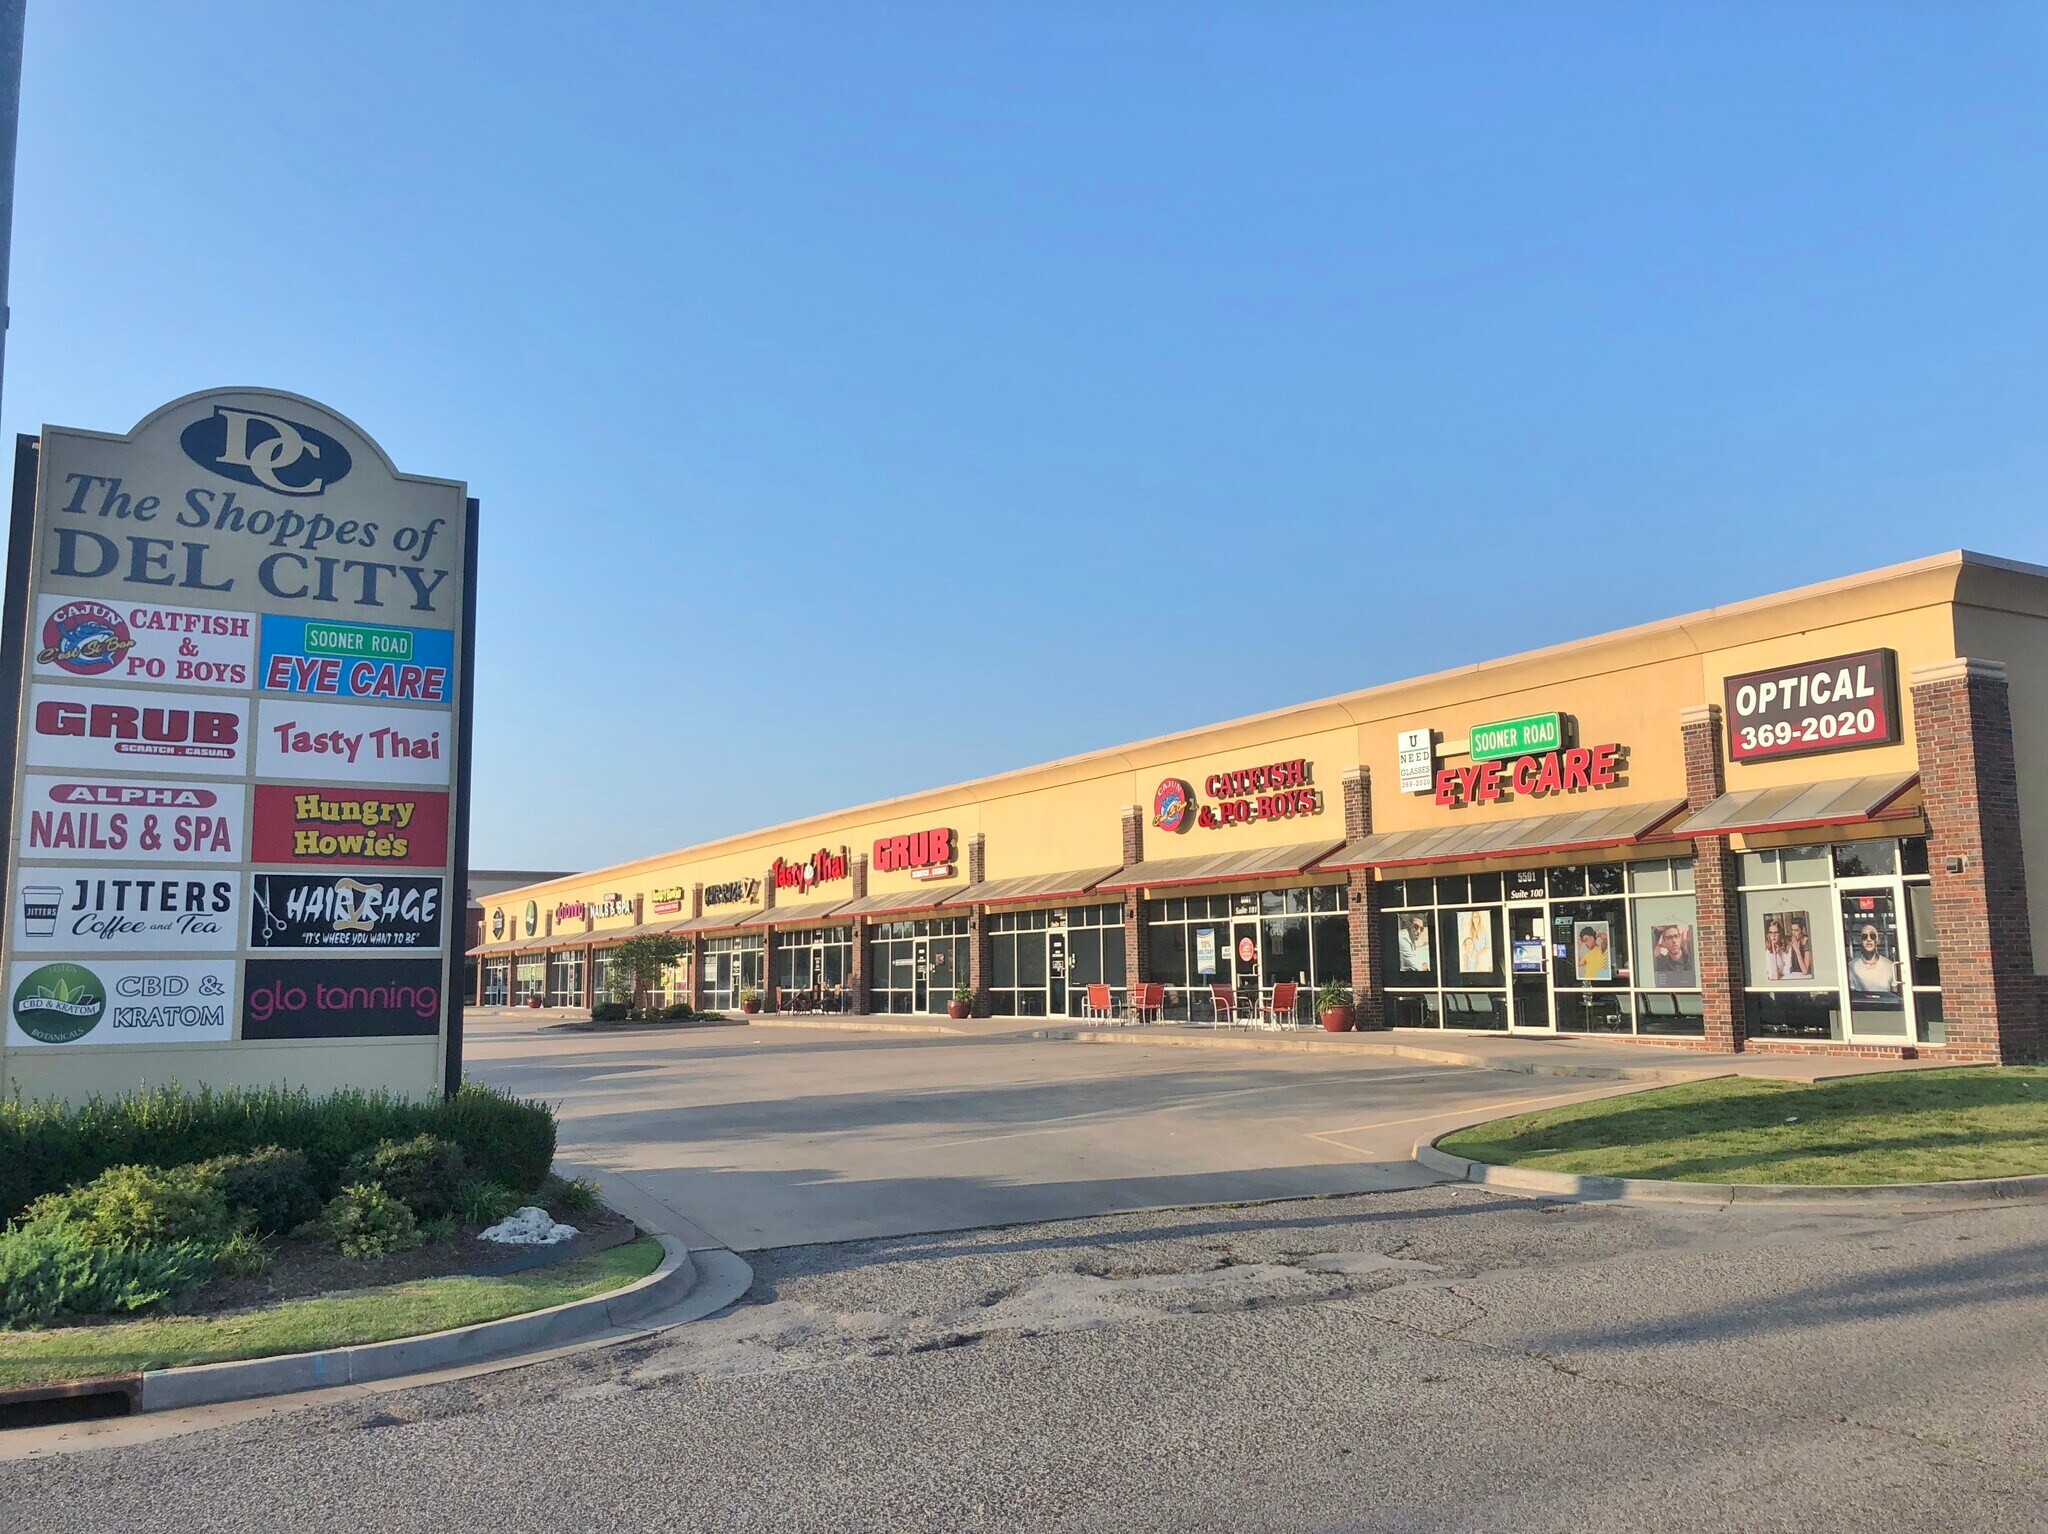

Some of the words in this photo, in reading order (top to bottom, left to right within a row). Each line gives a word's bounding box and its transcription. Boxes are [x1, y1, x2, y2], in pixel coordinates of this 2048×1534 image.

[62, 472, 160, 521] The
[177, 488, 379, 550] Shoppes
[393, 518, 446, 562] of
[50, 527, 234, 592] DEL
[259, 552, 449, 611] CITY
[53, 604, 123, 625] CAJUN
[129, 609, 250, 638] CATFISH
[178, 637, 200, 657] &
[310, 630, 364, 650] SOONER
[371, 635, 408, 654] ROAD
[126, 657, 166, 678] PO
[176, 660, 246, 684] BOYS
[265, 654, 342, 694] EYE
[350, 660, 447, 701] CARE
[1735, 665, 1875, 717] OPTICAL
[35, 700, 240, 744] GRUB
[1740, 708, 1875, 750] 369-2020
[120, 744, 175, 755] SCRATCH
[185, 747, 230, 757] CASUAL
[273, 721, 363, 763] Tasty
[369, 727, 440, 759] Thai
[1409, 734, 1418, 748] U
[1474, 727, 1518, 752] SOONER
[1523, 722, 1555, 745] ROAD
[1400, 751, 1430, 764] NEED
[1400, 765, 1430, 777] GLASSES
[1157, 780, 1182, 796] CAJUN
[1205, 759, 1304, 798] CATFISH
[1435, 760, 1502, 806] EYE
[1512, 743, 1617, 795] CARE
[67, 787, 201, 805] ALPHA
[293, 794, 415, 828] Hungry
[1198, 805, 1215, 828] &
[30, 810, 128, 850] NAILS
[140, 814, 162, 850] &
[173, 815, 231, 852] SPA
[293, 829, 408, 857] Howie's
[873, 827, 949, 870] GRUB
[772, 858, 804, 894] Tasty
[814, 845, 847, 881] Thai
[1517, 872, 1536, 883] 5501
[71, 879, 232, 913] JITTERS
[287, 885, 354, 923] HAIR
[361, 887, 438, 923] RAGE
[1511, 889, 1529, 899] Suite
[1530, 888, 1544, 898] 100
[27, 908, 57, 916] JITTERS
[1235, 906, 1248, 914] Suite
[71, 913, 147, 940] Coffee
[150, 922, 173, 931] and
[176, 913, 222, 934] Tea
[322, 932, 350, 944] WHERE
[352, 932, 367, 945] YOU
[370, 932, 392, 944] WANT
[393, 932, 404, 944] TO
[115, 975, 189, 997] CBD
[199, 975, 225, 996] &
[23, 1000, 42, 1009] CBD
[56, 1002, 96, 1015] KRATOM
[250, 979, 307, 1021] glo
[317, 980, 437, 1018] tanning
[113, 1005, 224, 1028] KRATOM
[31, 1028, 84, 1041] BOTANICALS
